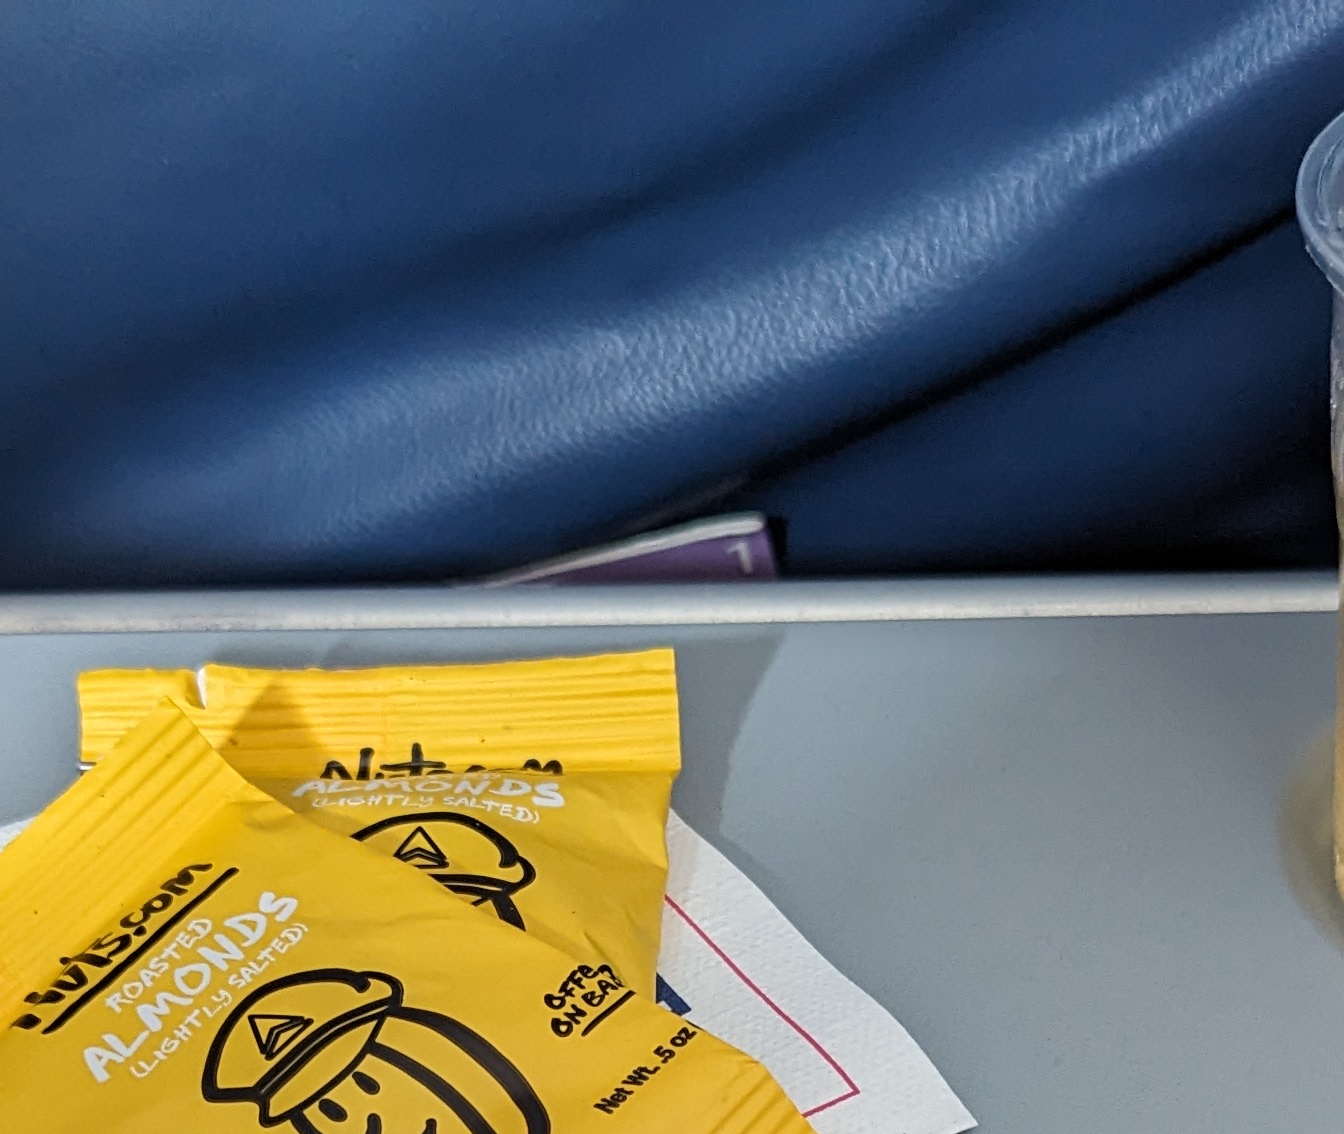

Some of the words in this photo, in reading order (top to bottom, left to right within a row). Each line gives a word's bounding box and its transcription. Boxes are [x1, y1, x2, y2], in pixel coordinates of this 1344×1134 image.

[442, 796, 540, 824] SALTED)
[84, 891, 297, 1083] ALMONDS
[105, 918, 212, 1013] ROASTED
[130, 988, 233, 1078] (LIGHTLY
[227, 923, 308, 989] SALTED)
[551, 1004, 587, 1037] ON
[593, 1087, 635, 1114] Net
[621, 1066, 661, 1086] Wt.
[670, 1027, 697, 1047] oz
